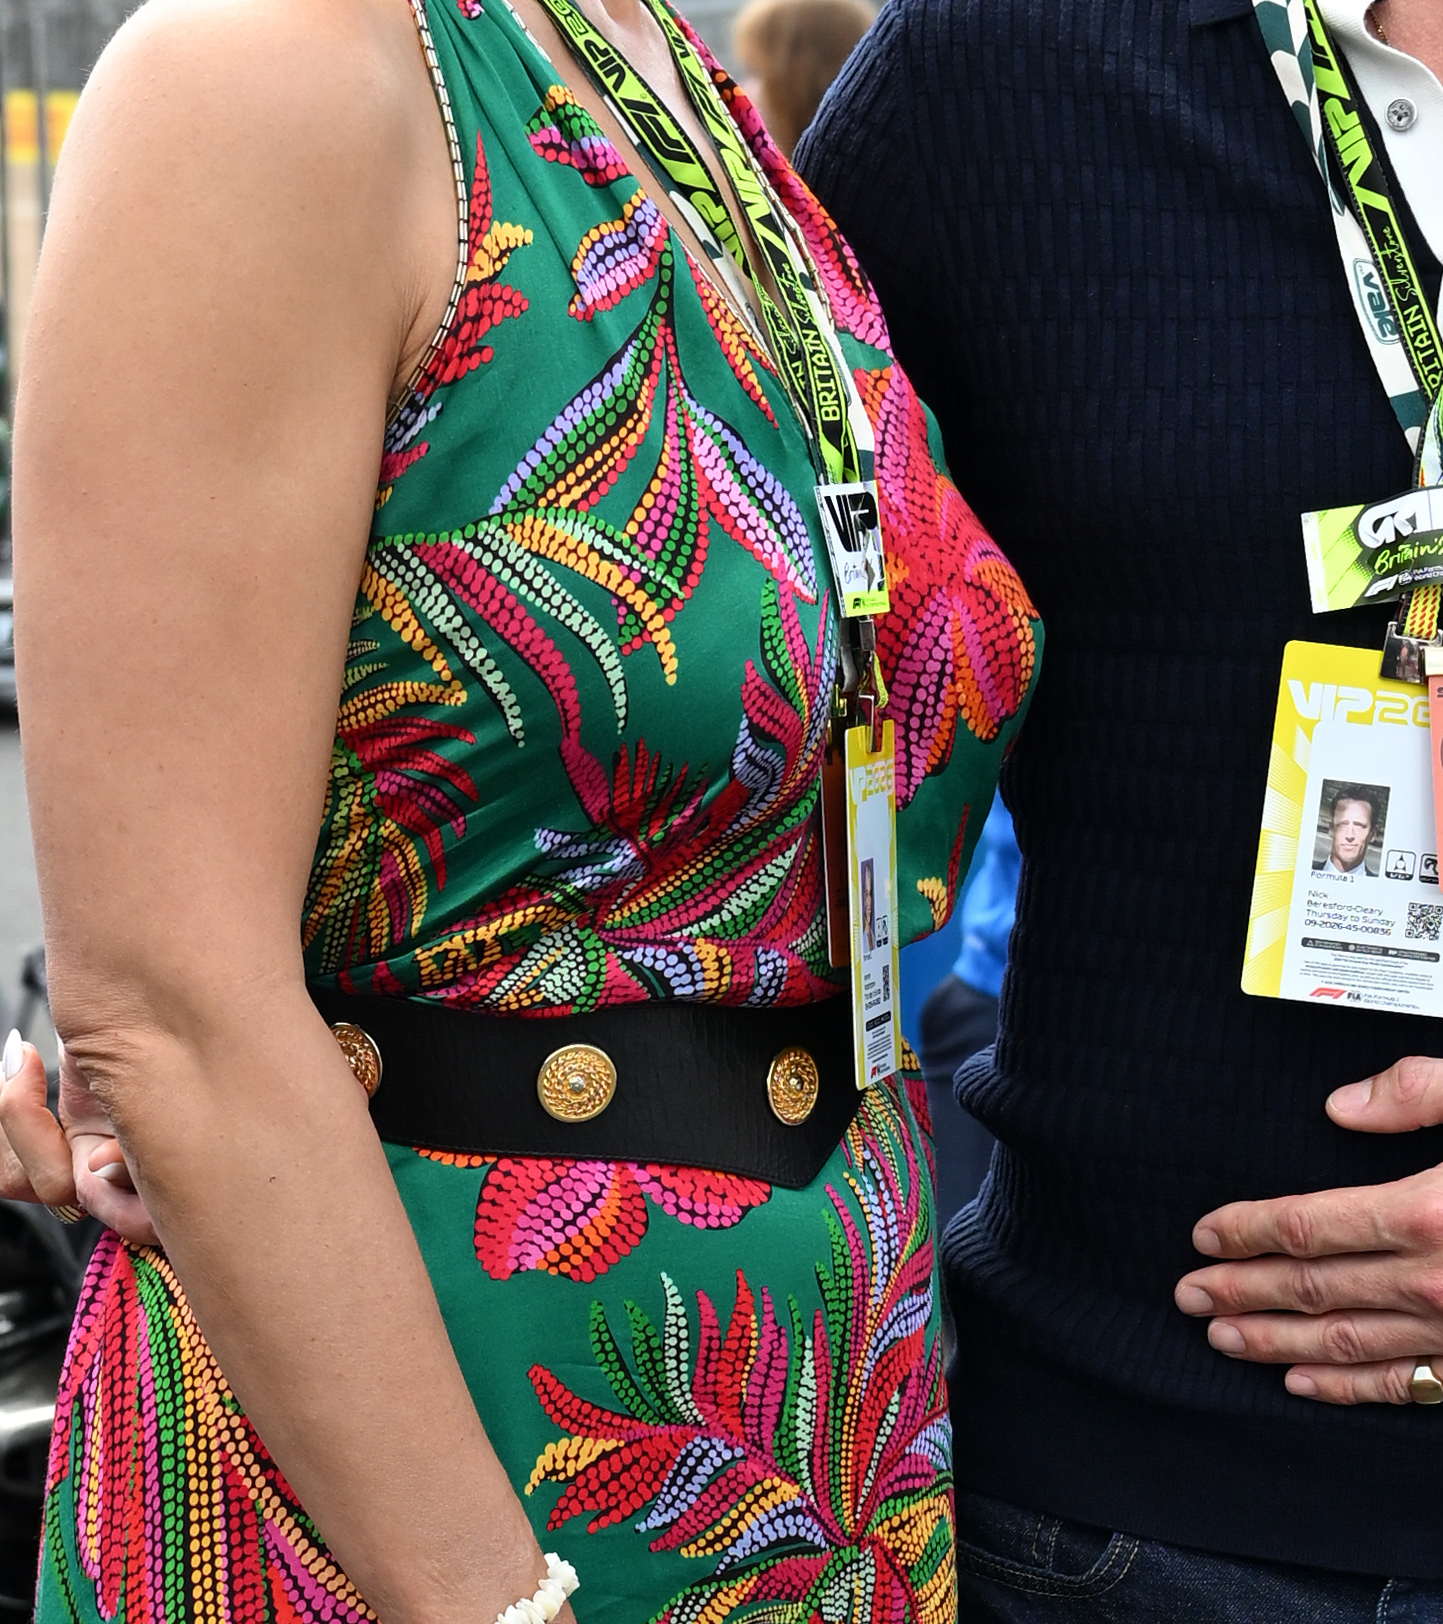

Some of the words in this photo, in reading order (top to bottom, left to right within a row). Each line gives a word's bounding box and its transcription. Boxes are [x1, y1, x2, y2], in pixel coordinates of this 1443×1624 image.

[1403, 304, 1443, 390] RITAIN
[801, 327, 841, 423] BRITAIN
[1305, 908, 1349, 922] Thursday
[1349, 913, 1360, 923] to
[1361, 916, 1396, 928] Sunday
[1307, 889, 1329, 899] Nick
